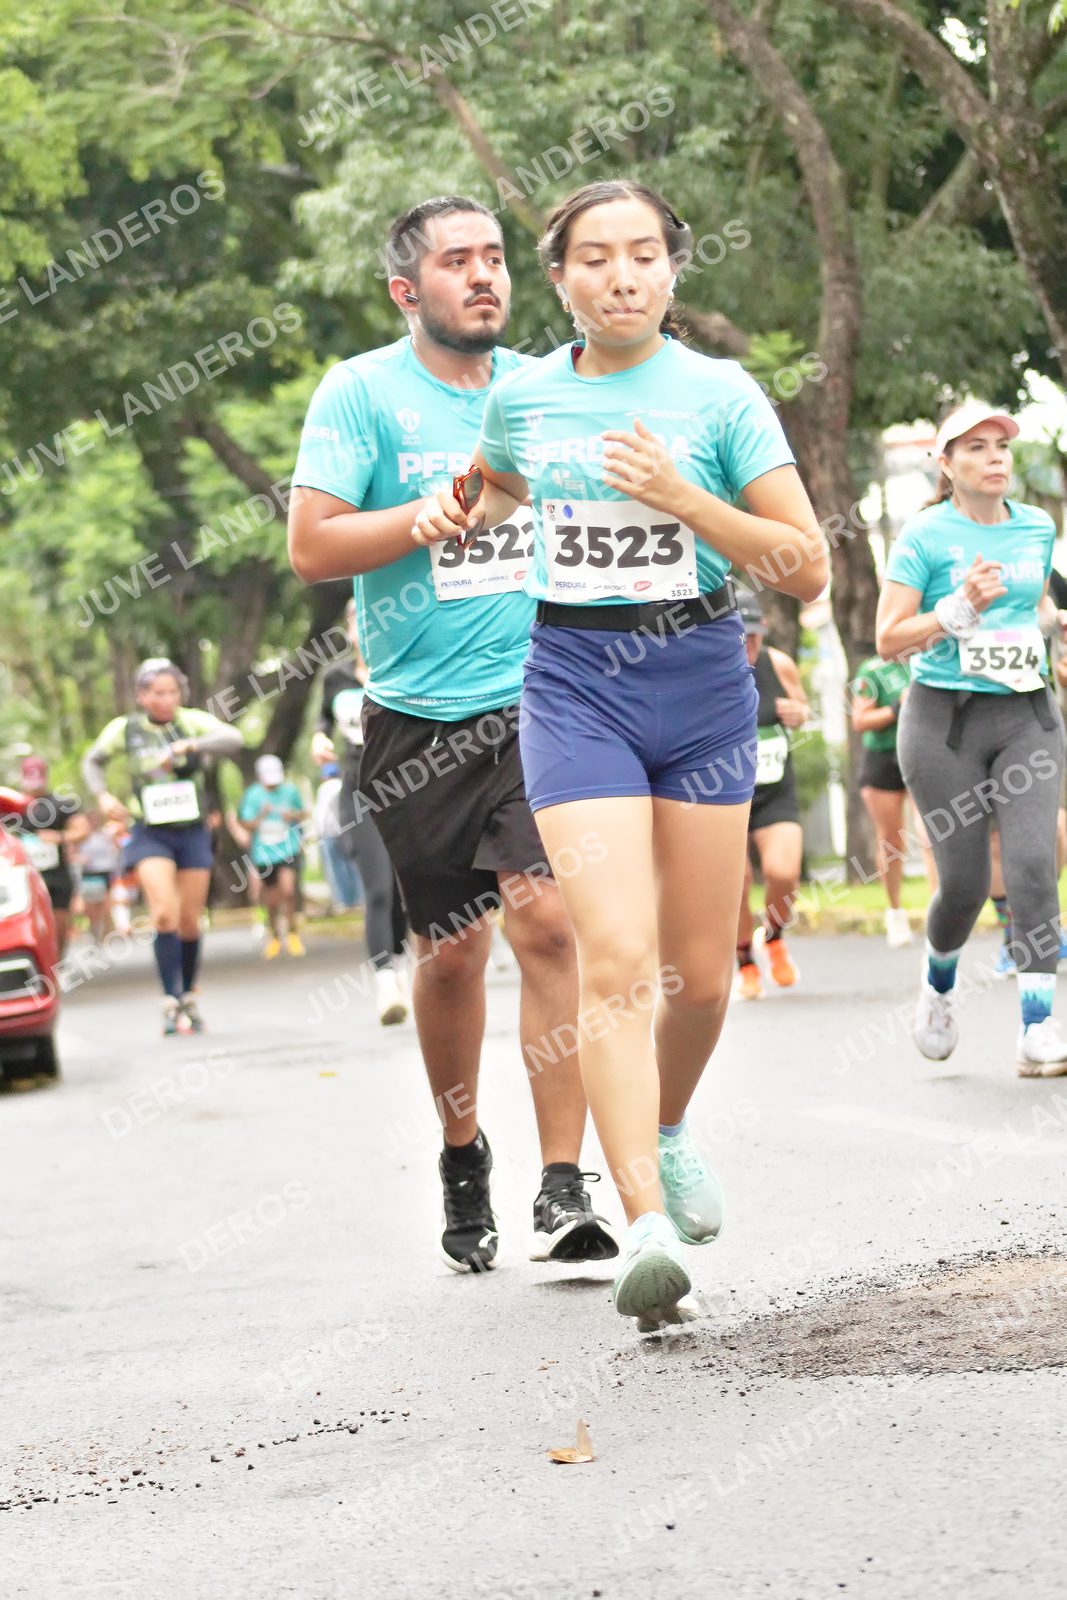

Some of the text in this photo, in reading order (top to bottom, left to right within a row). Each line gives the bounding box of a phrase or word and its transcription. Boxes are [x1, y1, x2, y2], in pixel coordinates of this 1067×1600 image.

[525, 432, 691, 465] PERDA
[554, 523, 684, 568] 3523
[671, 588, 694, 598] 3523
[967, 646, 1040, 671] 3524
